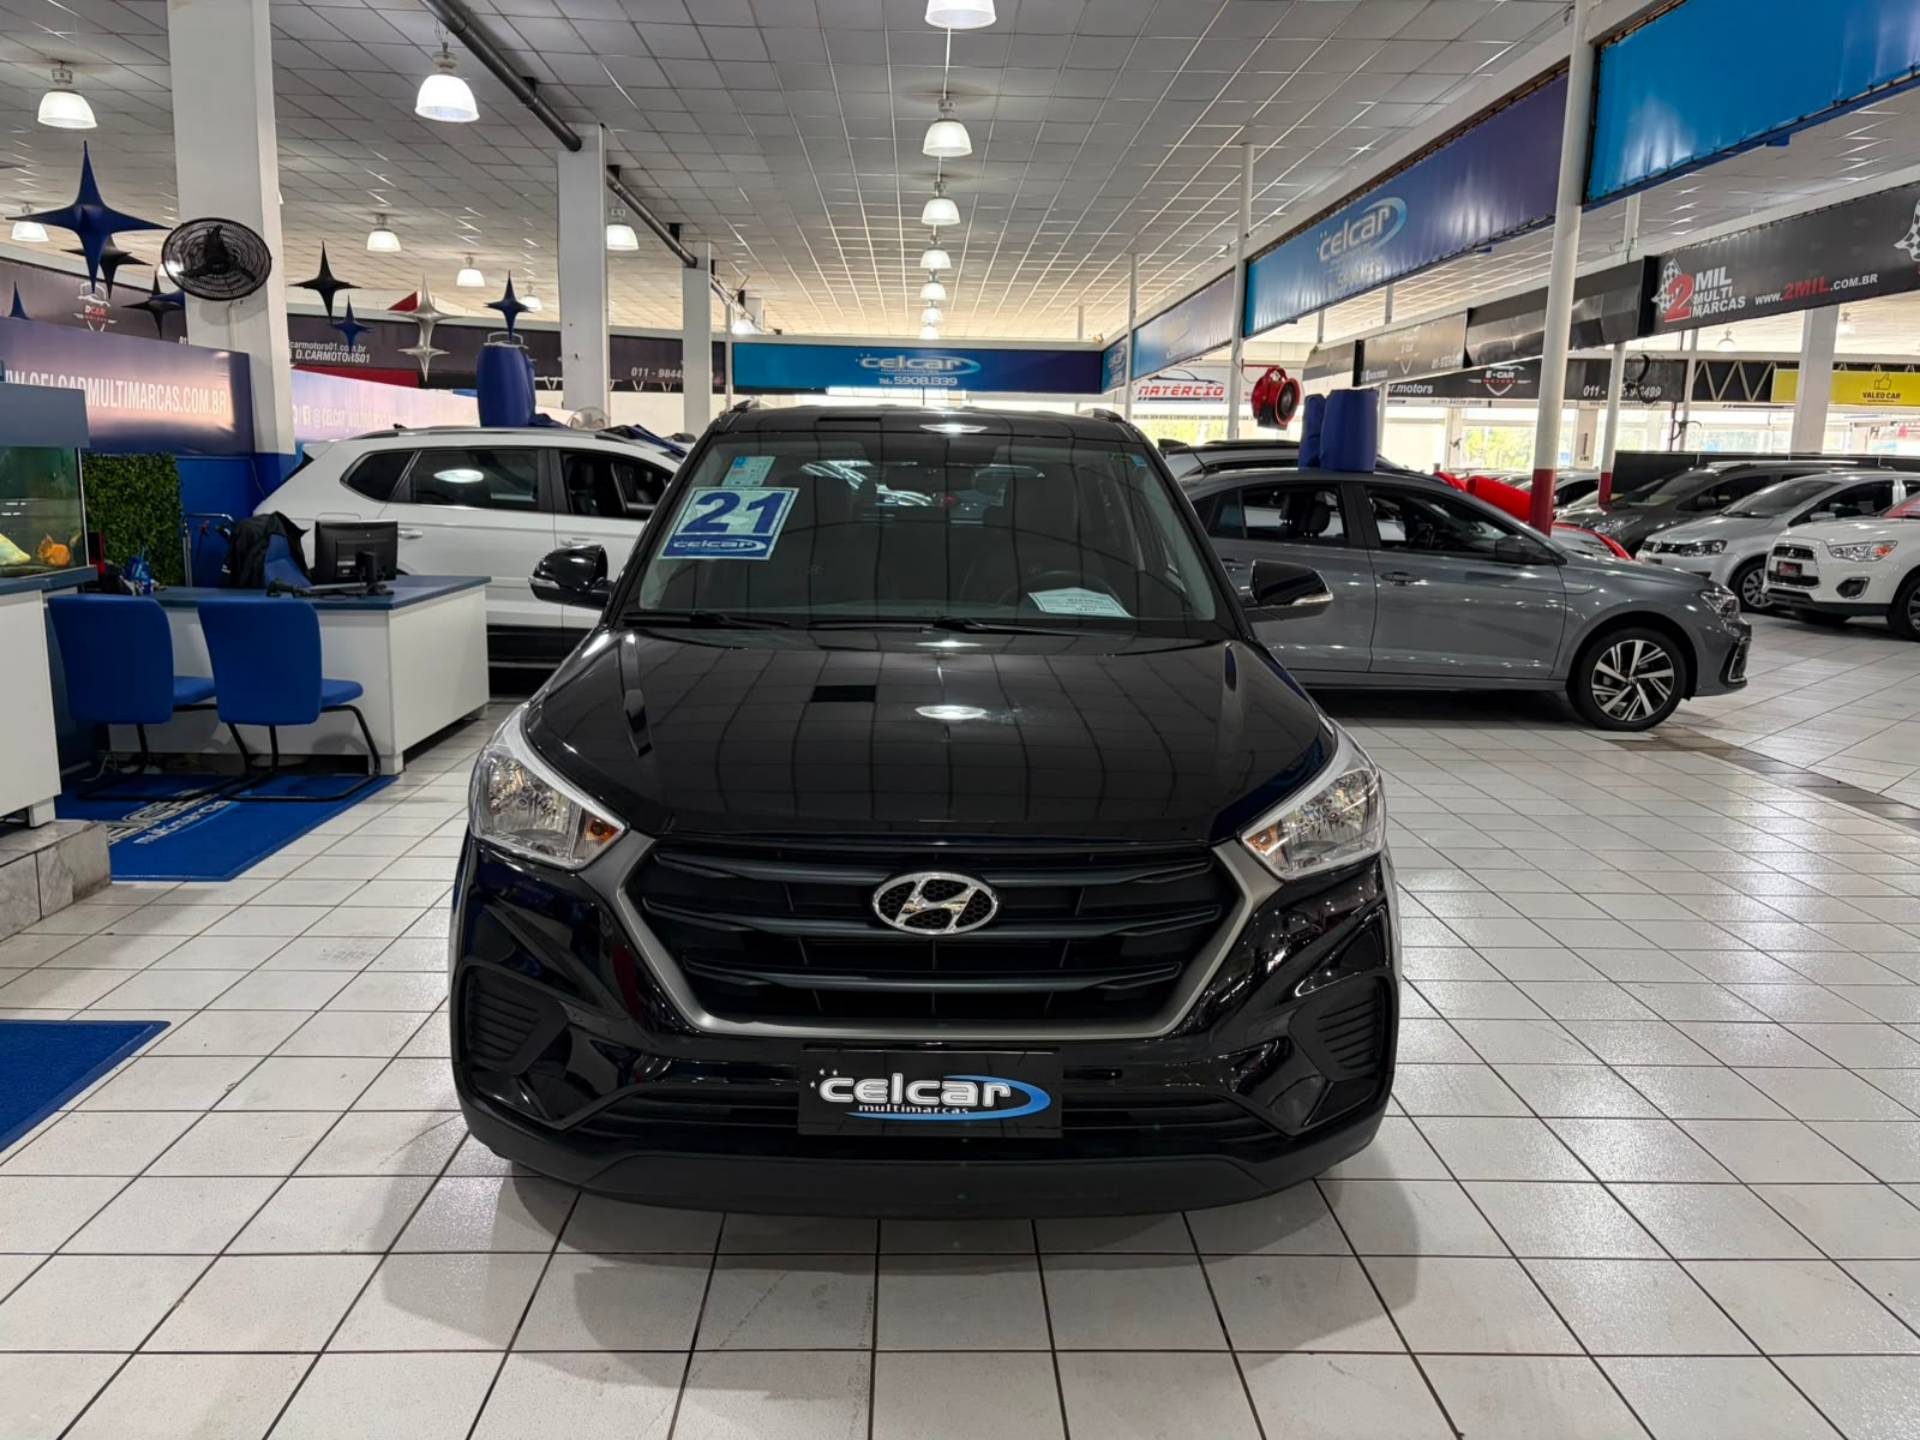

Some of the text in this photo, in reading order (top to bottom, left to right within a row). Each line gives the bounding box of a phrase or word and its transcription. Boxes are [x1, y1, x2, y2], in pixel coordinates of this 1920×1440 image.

[1319, 206, 1390, 262] celcar
[1695, 267, 1732, 291] MIL
[1693, 288, 1733, 305] MULTI
[1693, 296, 1746, 318] MARCAS
[861, 355, 961, 370] celcar
[631, 367, 648, 378] 011
[658, 368, 683, 379] 9844
[1583, 384, 1600, 397] 011
[681, 491, 787, 534] 21
[819, 1072, 1012, 1108] celcar
[858, 1103, 969, 1116] multimarcas
